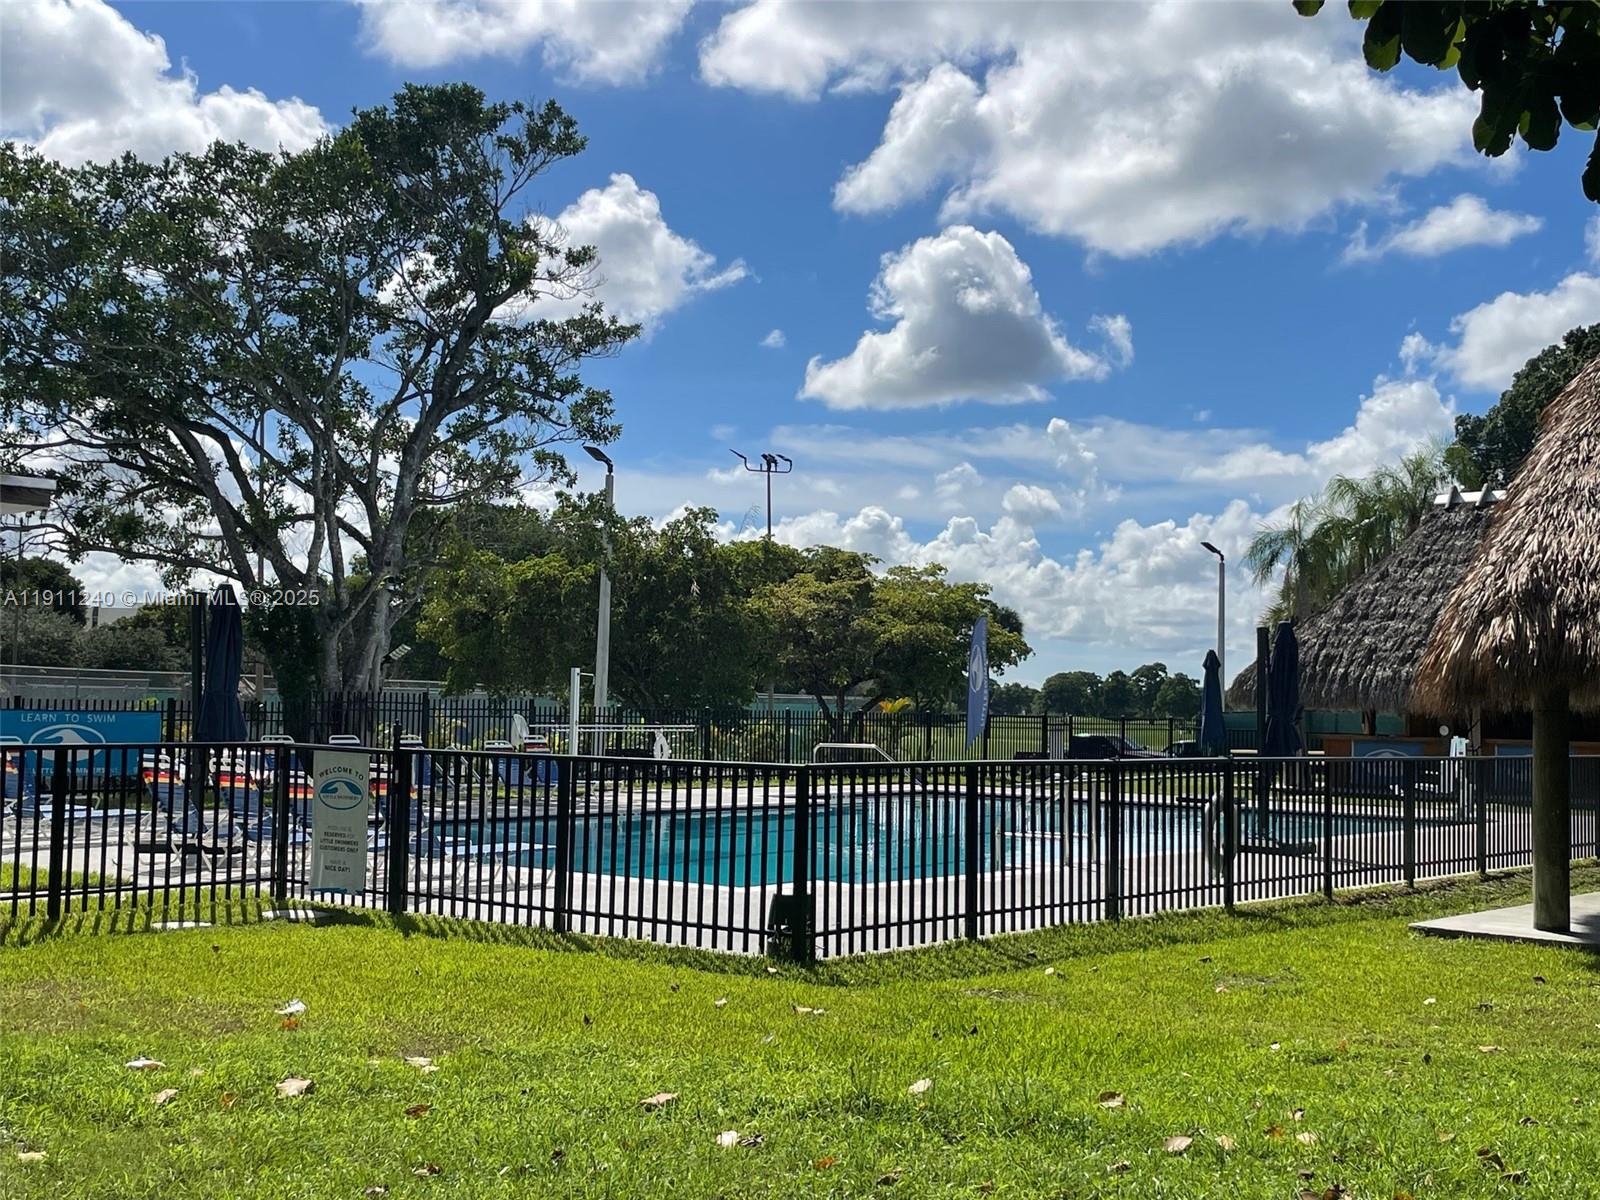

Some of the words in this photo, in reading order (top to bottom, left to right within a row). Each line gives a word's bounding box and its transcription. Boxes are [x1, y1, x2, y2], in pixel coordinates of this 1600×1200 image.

[20, 713, 57, 723] LEARN
[64, 713, 80, 723] TO
[87, 713, 116, 723] SWIM
[319, 766, 352, 778] WELCOME
[355, 771, 364, 781] TO
